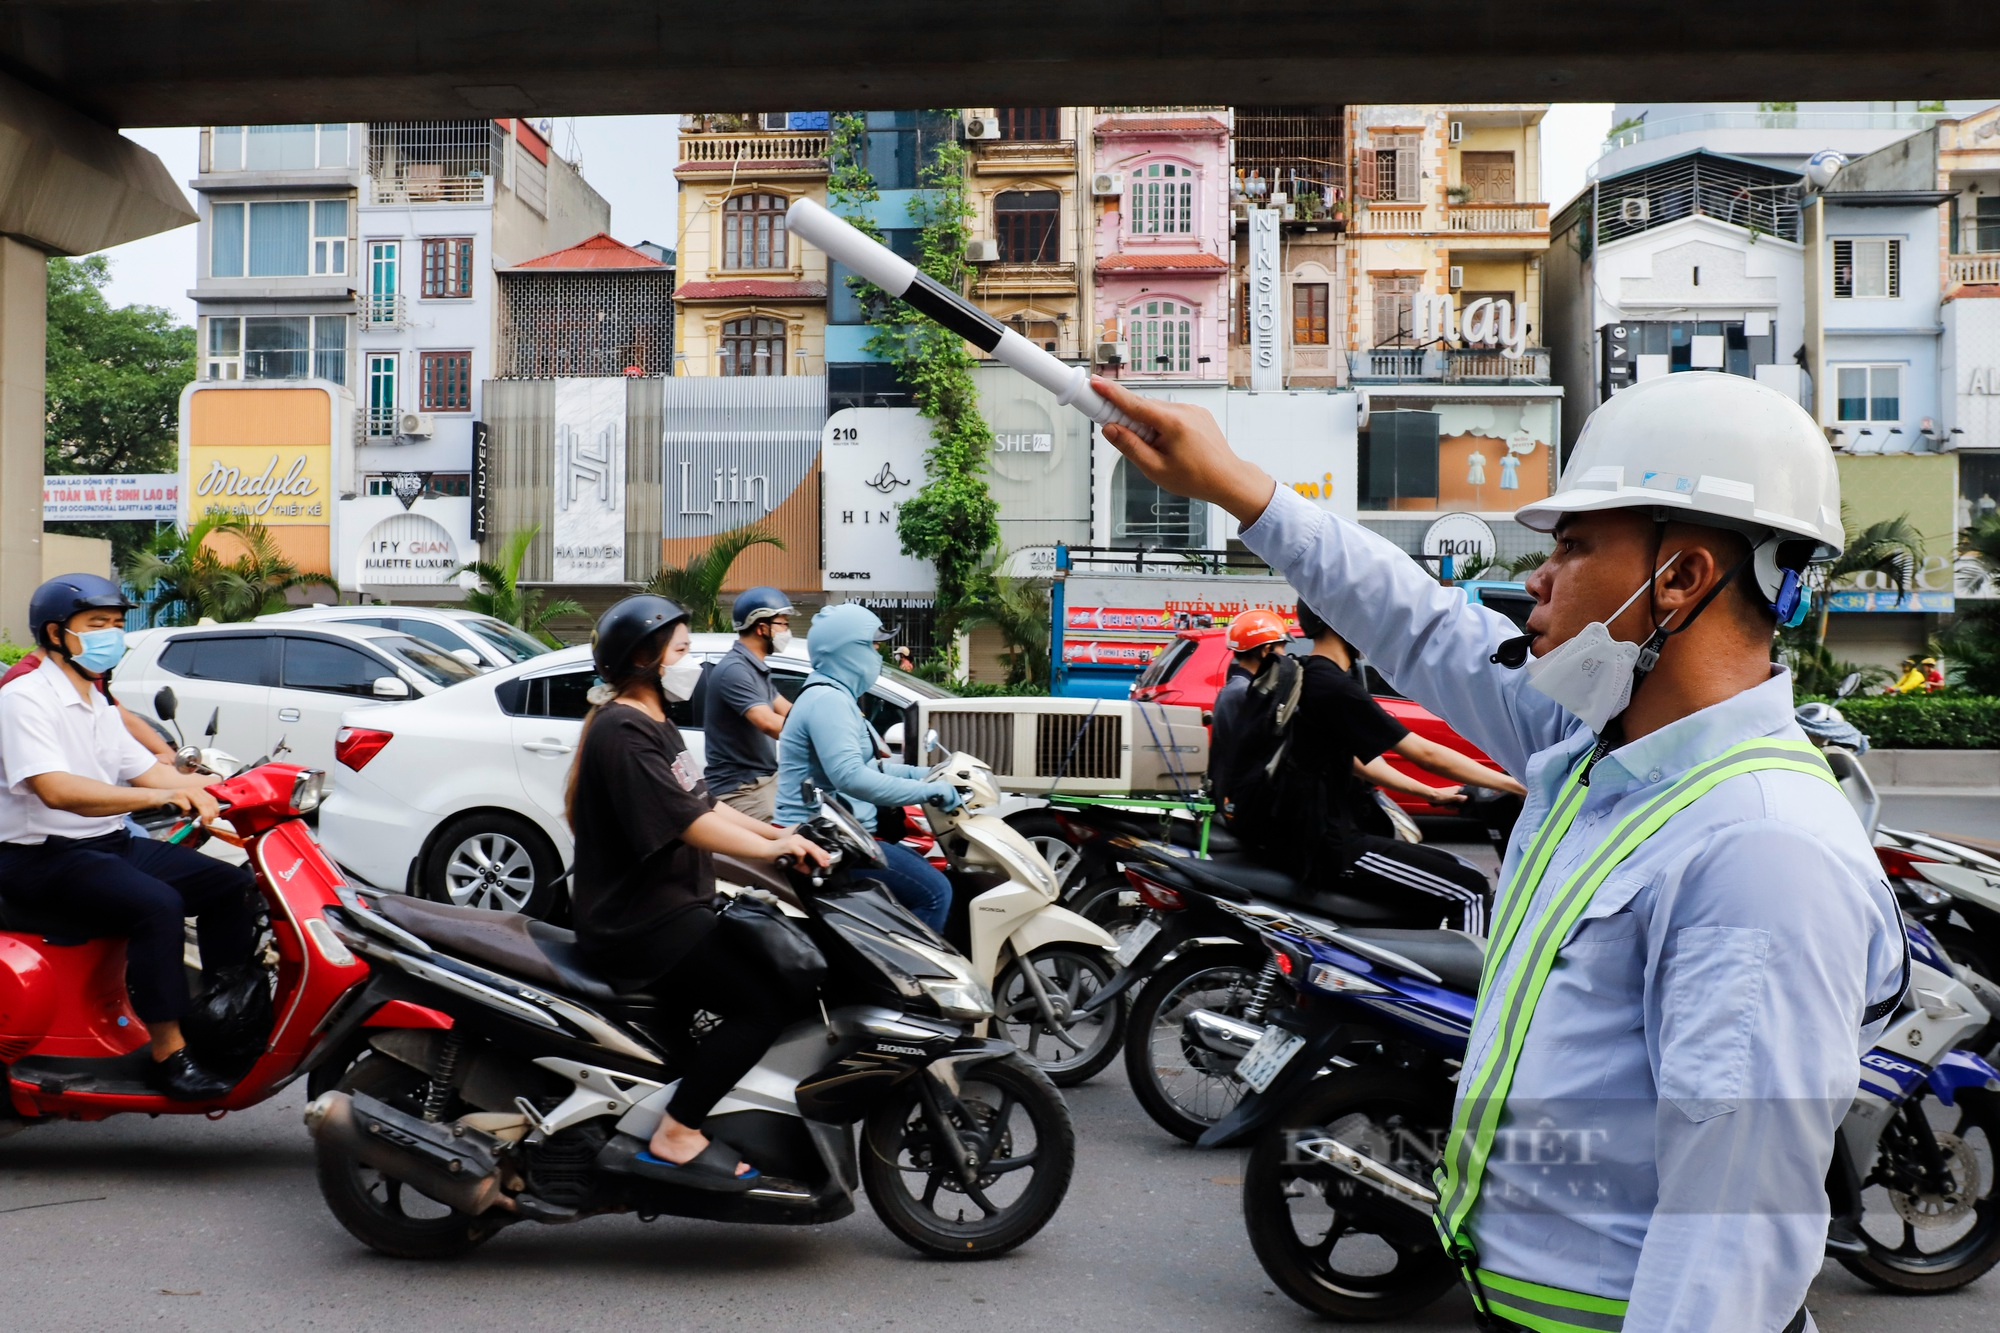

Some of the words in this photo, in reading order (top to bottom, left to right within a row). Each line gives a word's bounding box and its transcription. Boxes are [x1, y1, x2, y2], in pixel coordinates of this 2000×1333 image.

[1412, 291, 1528, 359] may
[832, 427, 858, 440] 210
[994, 433, 1031, 452] SHE
[478, 431, 487, 499] HUYEN
[197, 453, 319, 516] Medyla
[679, 460, 773, 517] Liin
[1284, 471, 1333, 499] mi
[53, 487, 81, 502] TOÀN
[84, 486, 97, 502] VÀ
[99, 486, 112, 504] VỆ
[115, 488, 139, 501] SINH
[143, 488, 162, 501] LAO
[69, 505, 117, 513] OCCUPATIONAL
[272, 501, 305, 516] THIẾT
[306, 501, 323, 516] KẾ
[842, 510, 891, 525] HIN
[555, 545, 574, 559] HA
[576, 545, 622, 559] HUYEN
[365, 558, 412, 569] JULIETTE
[415, 558, 456, 568] LUXURY
[829, 571, 871, 580] COSMETICS
[901, 598, 935, 609] HINHY
[1219, 598, 1250, 613] NHÀ
[978, 905, 1006, 913] HONDA
[876, 1043, 928, 1056] HONDA
